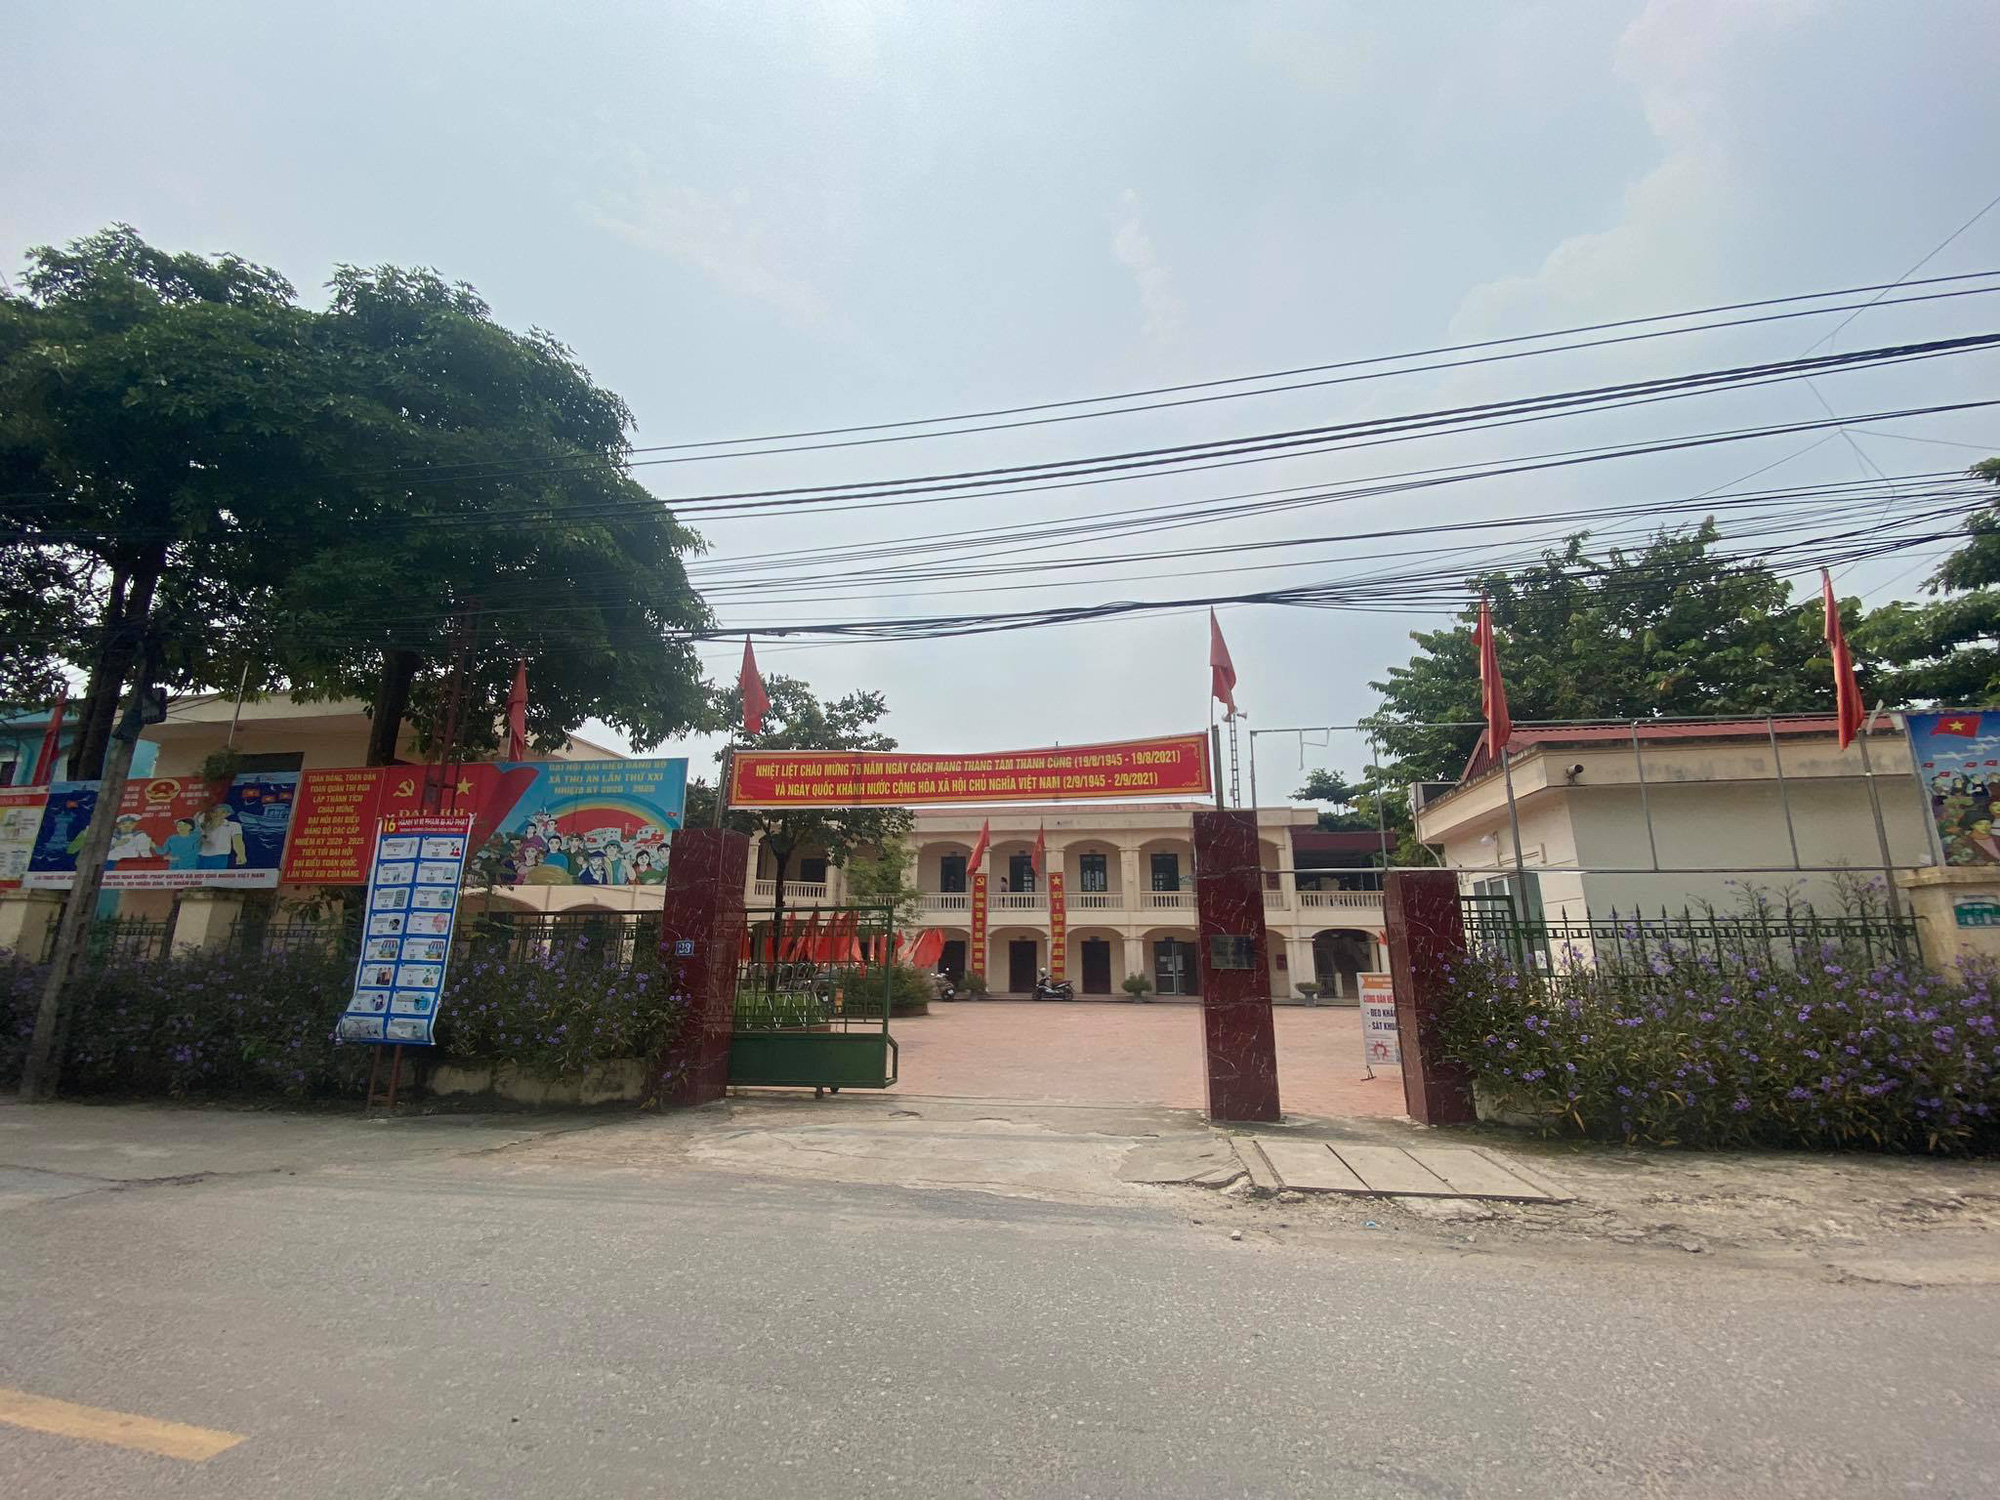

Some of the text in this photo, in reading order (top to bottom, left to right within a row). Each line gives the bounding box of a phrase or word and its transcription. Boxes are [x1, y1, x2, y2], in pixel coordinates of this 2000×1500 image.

[756, 763, 779, 779] NHIỆT
[782, 763, 798, 779] LIỆT
[800, 762, 821, 776] CHÀO
[824, 762, 849, 776] MỪNG
[864, 762, 883, 775] NĂM
[886, 761, 908, 775] NGÀY
[910, 761, 933, 774] CÁCH
[936, 760, 961, 775] MẠNG
[964, 759, 992, 771] THÁNG
[995, 758, 1013, 770] TÁM
[1016, 757, 1044, 770] THÀNH
[1048, 755, 1072, 769] CÔNG
[1074, 753, 1123, 768] (19/8/1945
[1132, 750, 1181, 765] 19/8/2021)
[775, 781, 785, 796] VÀ
[788, 781, 809, 796] NGÀY
[812, 780, 834, 796] QUỐC
[836, 780, 864, 796] KHÁNH
[867, 779, 890, 794] NƯỚC
[892, 780, 916, 797] CỘNG
[918, 778, 935, 793] HÒA
[938, 777, 950, 793] XÃ
[952, 777, 966, 794] HỘI
[969, 774, 986, 791] CHỦ
[989, 776, 1016, 790] NGHĨA
[1019, 775, 1037, 792] VIỆT
[1040, 777, 1060, 789] NAM
[1063, 774, 1105, 789] (2/9/1945
[1114, 772, 1158, 786] 2/9/2021)
[383, 819, 396, 832] 16
[1370, 1009, 1382, 1017] ĐEO
[1372, 1022, 1383, 1030] SÁT
